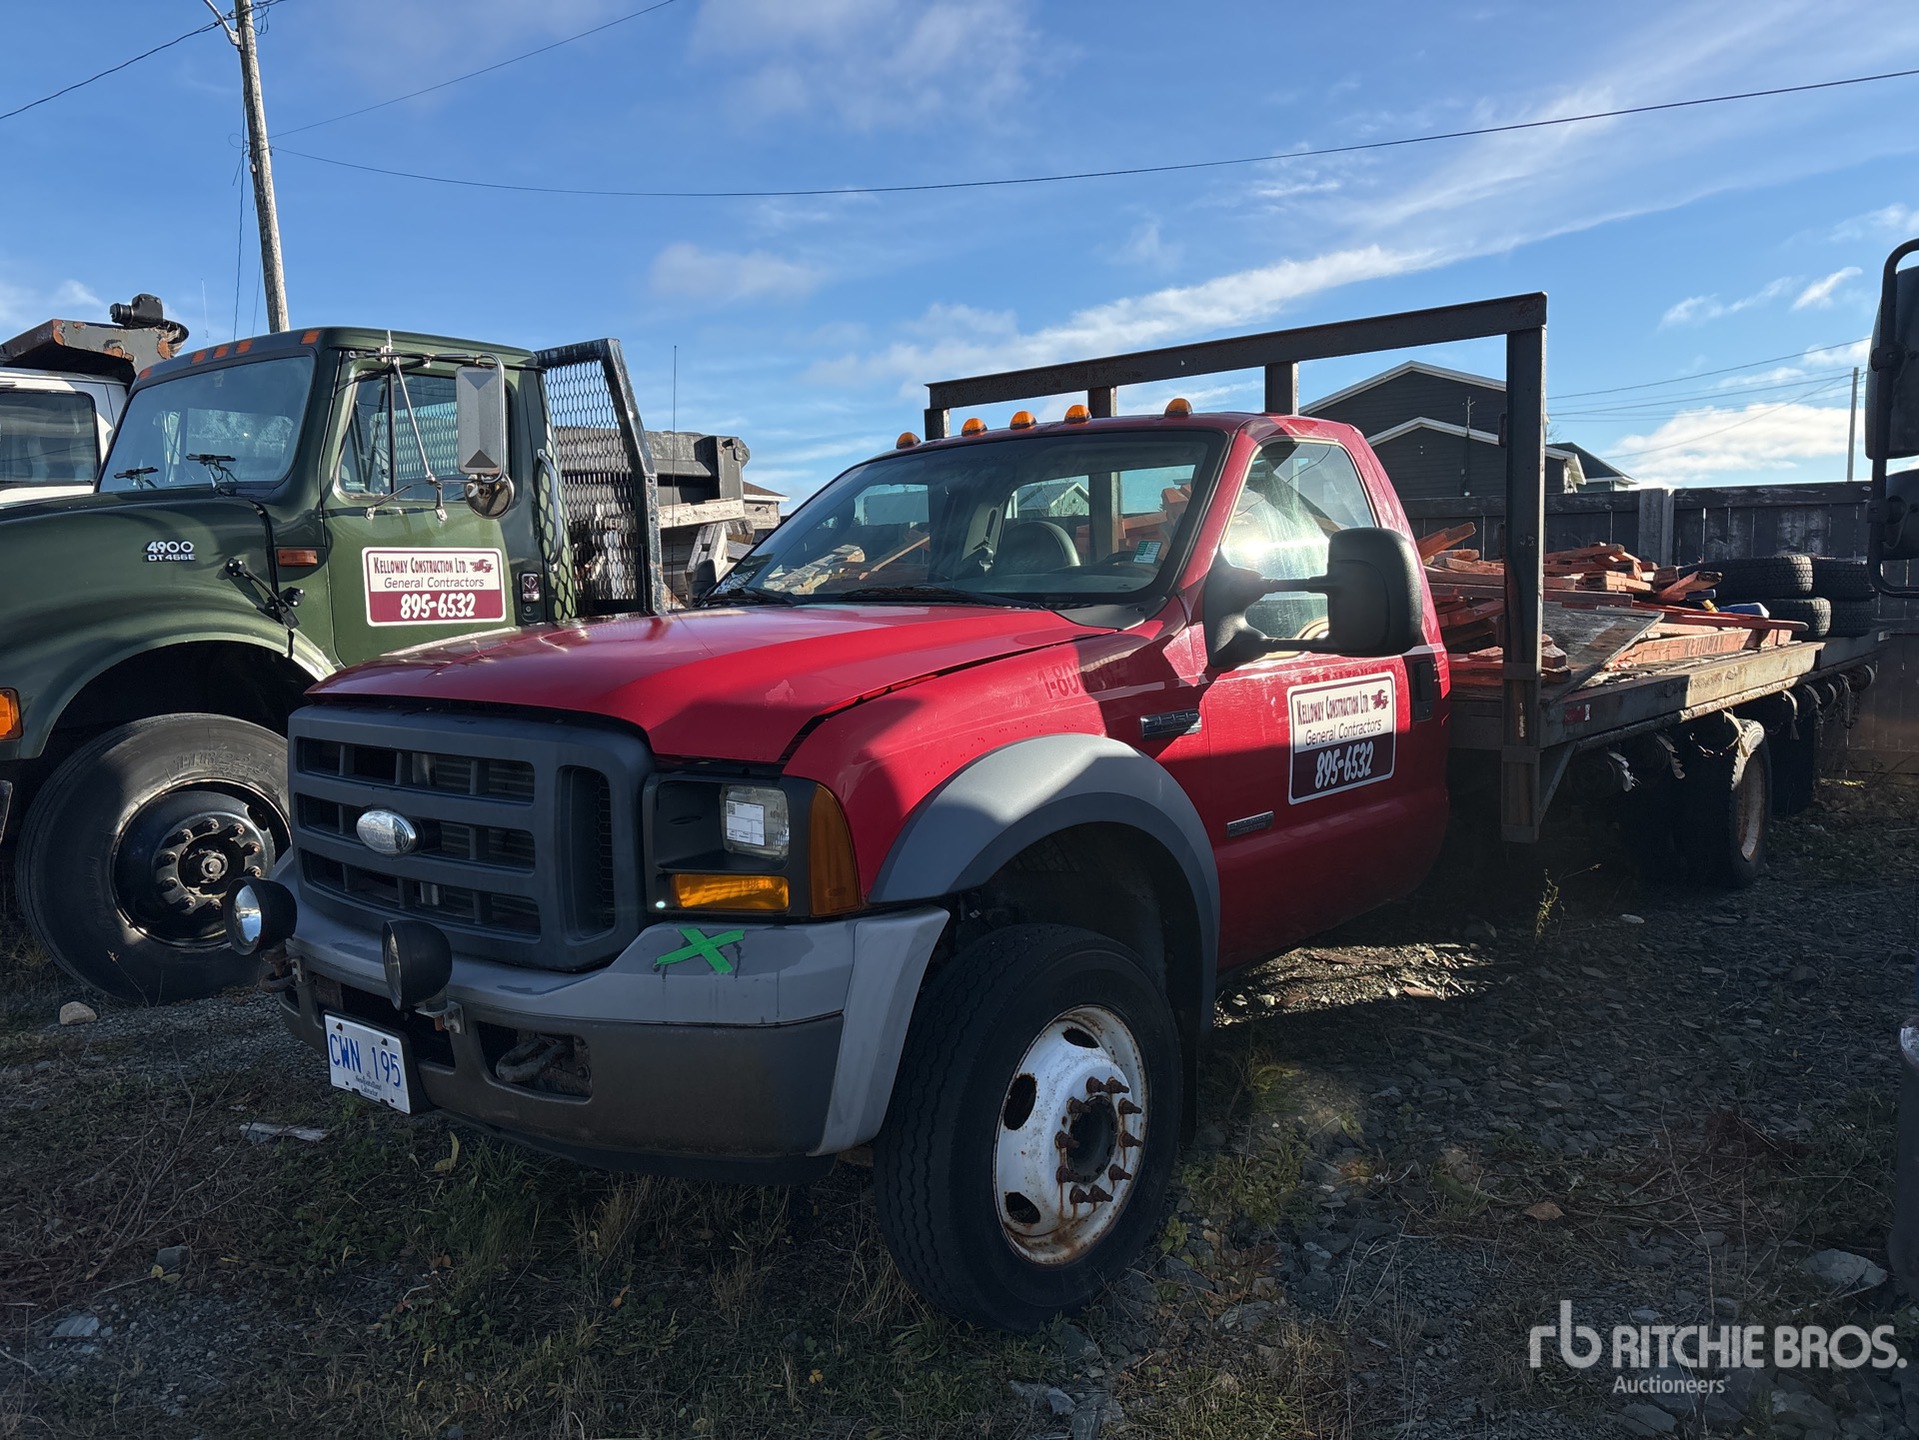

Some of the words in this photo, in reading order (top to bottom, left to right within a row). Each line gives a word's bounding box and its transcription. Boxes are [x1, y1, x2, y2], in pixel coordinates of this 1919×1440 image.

[147, 541, 194, 553] 4900
[373, 556, 408, 574] KELLOWAY
[410, 557, 453, 574] CONSTRUCTION
[455, 557, 468, 574] LTD.
[384, 577, 424, 589] General
[427, 576, 484, 588] Contractors
[400, 592, 476, 620] 895-6532
[1296, 699, 1324, 726] KELLOWAY
[1326, 694, 1359, 721] CONSTRUCTION
[1305, 724, 1336, 746] General
[1338, 718, 1382, 739] Contractors
[1315, 740, 1374, 789] 895-6532
[329, 1033, 362, 1074] CWN
[371, 1046, 401, 1088] 195
